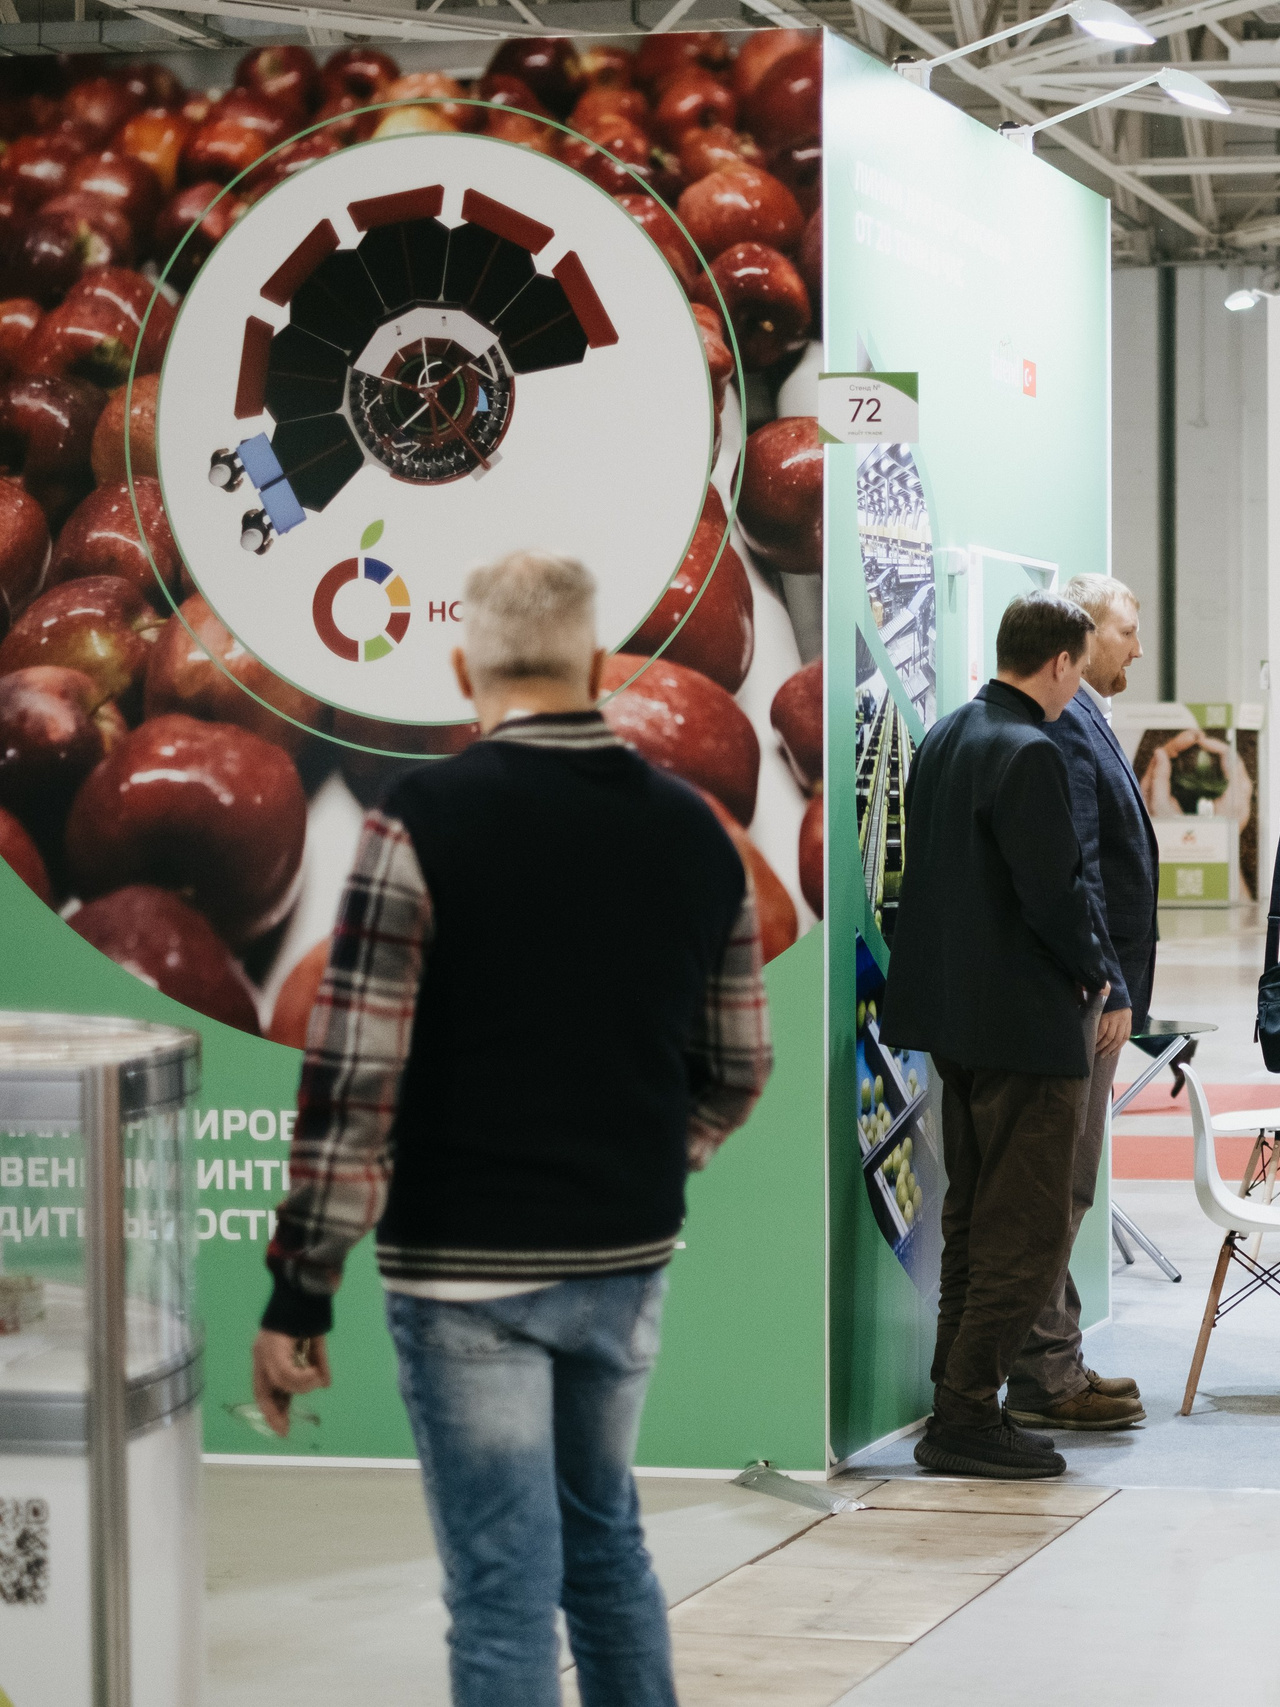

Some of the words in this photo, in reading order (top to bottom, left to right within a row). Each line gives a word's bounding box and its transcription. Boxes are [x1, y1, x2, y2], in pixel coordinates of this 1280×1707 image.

[849, 384, 871, 392] Стенд
[848, 397, 882, 423] 72
[429, 600, 464, 622] НО
